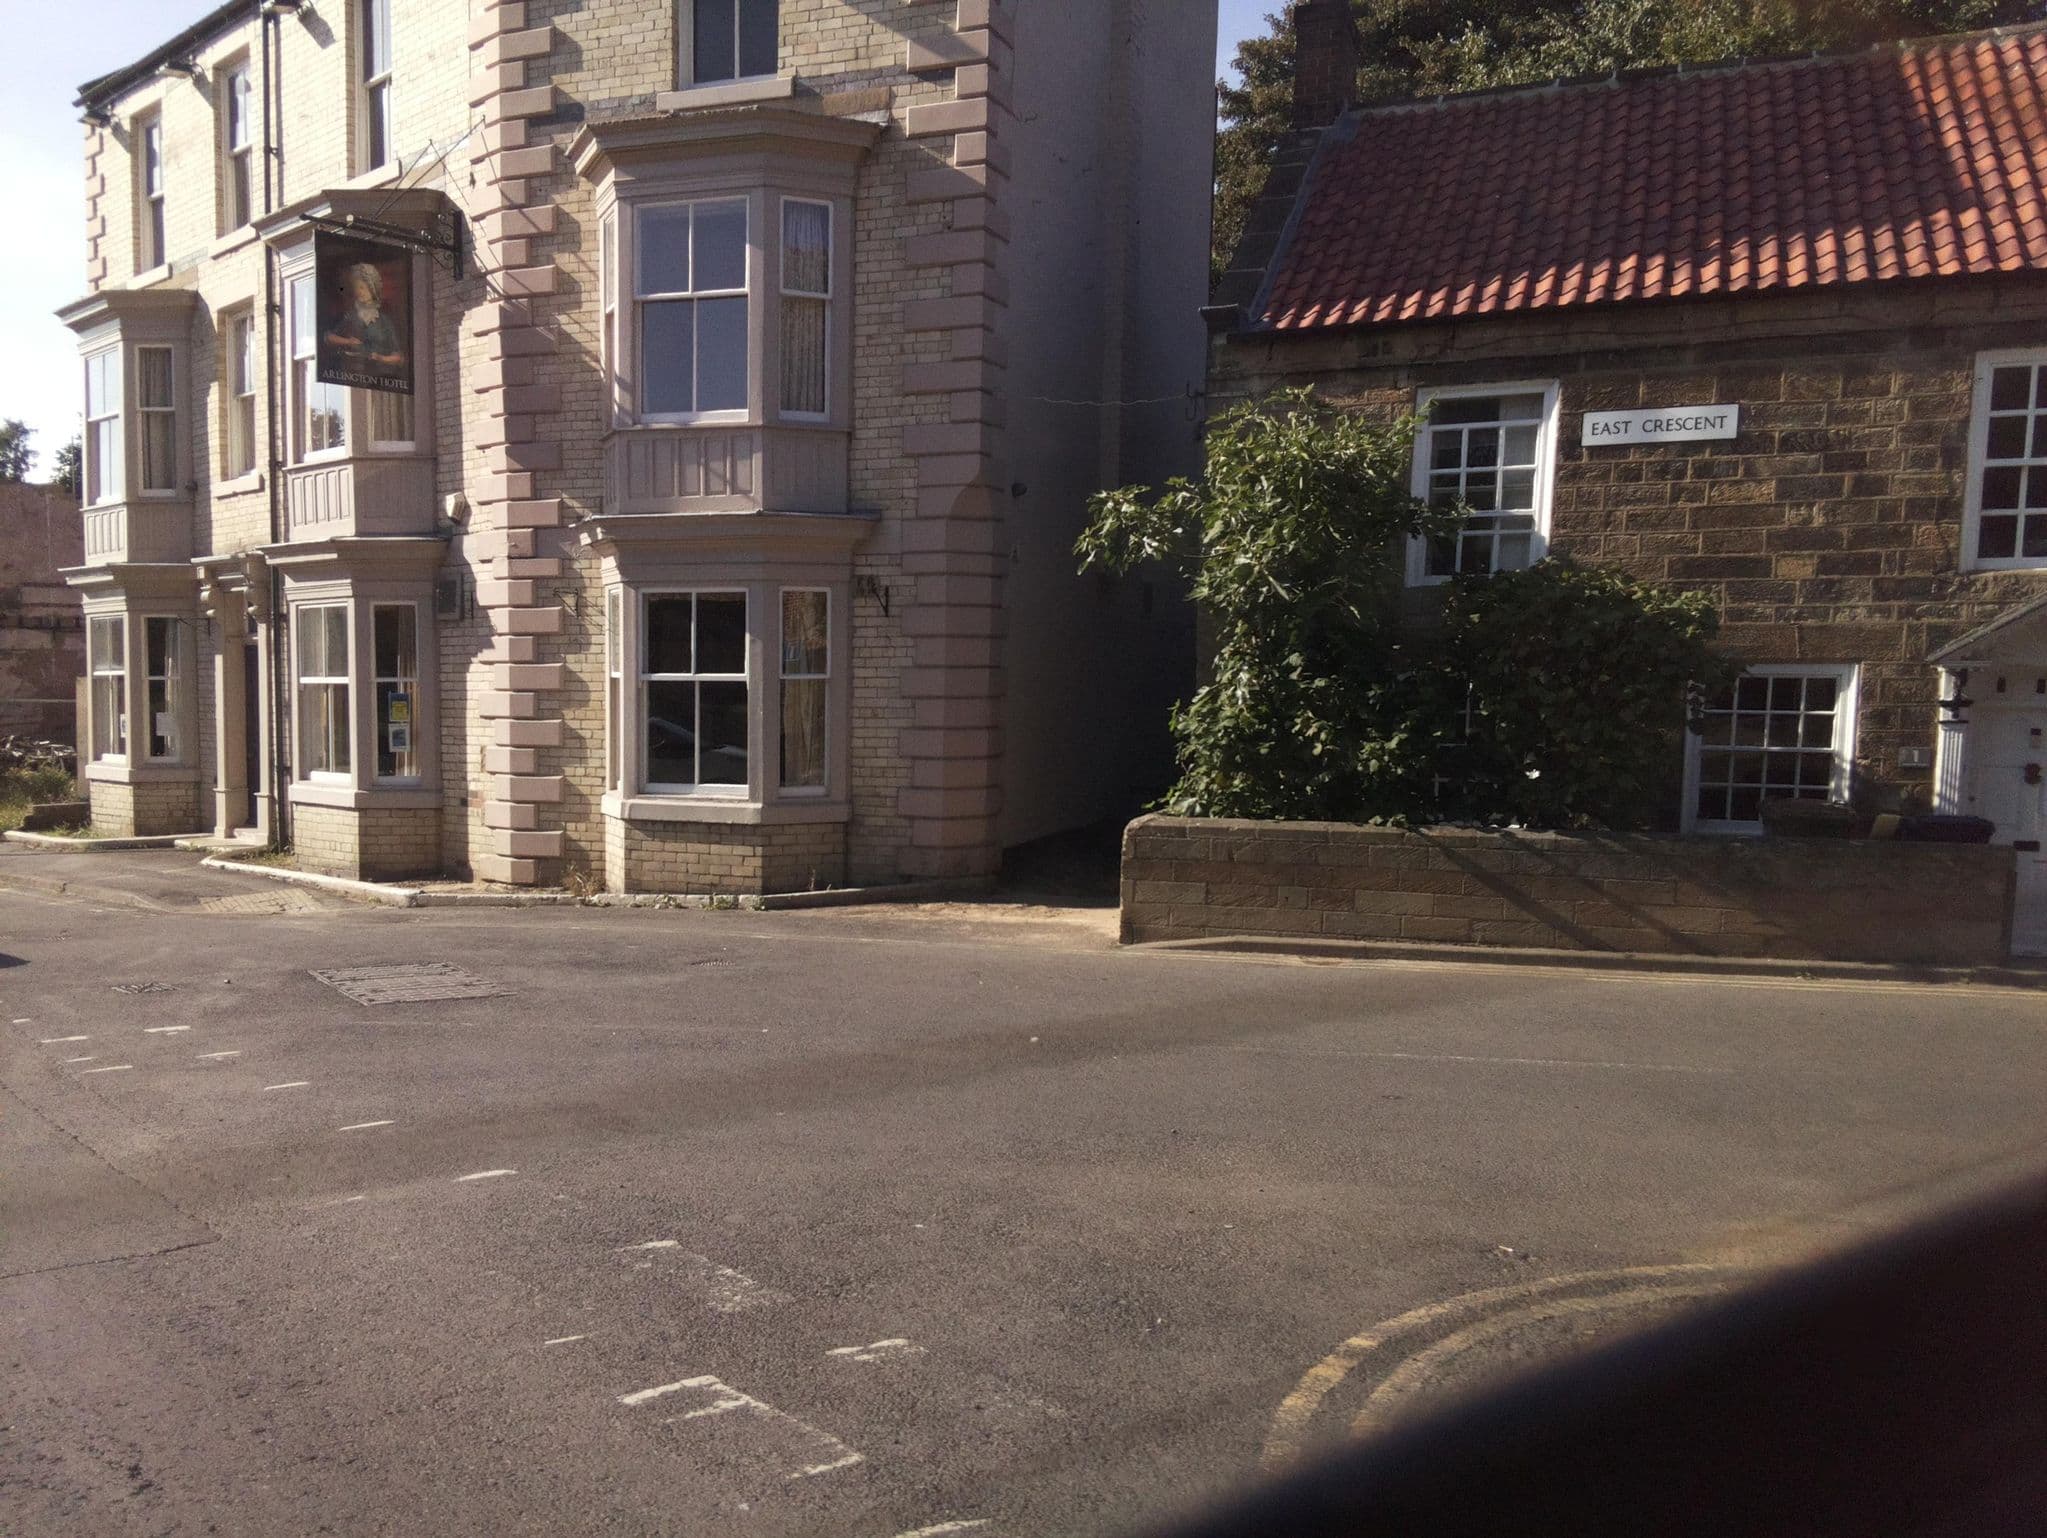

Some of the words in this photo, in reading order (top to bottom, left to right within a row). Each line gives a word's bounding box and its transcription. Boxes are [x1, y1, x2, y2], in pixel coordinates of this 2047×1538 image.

[323, 369, 378, 384] ARLINGTON
[380, 377, 408, 389] HOTEL
[1591, 420, 1632, 436] EAST
[1642, 415, 1728, 433] CRESCENT
